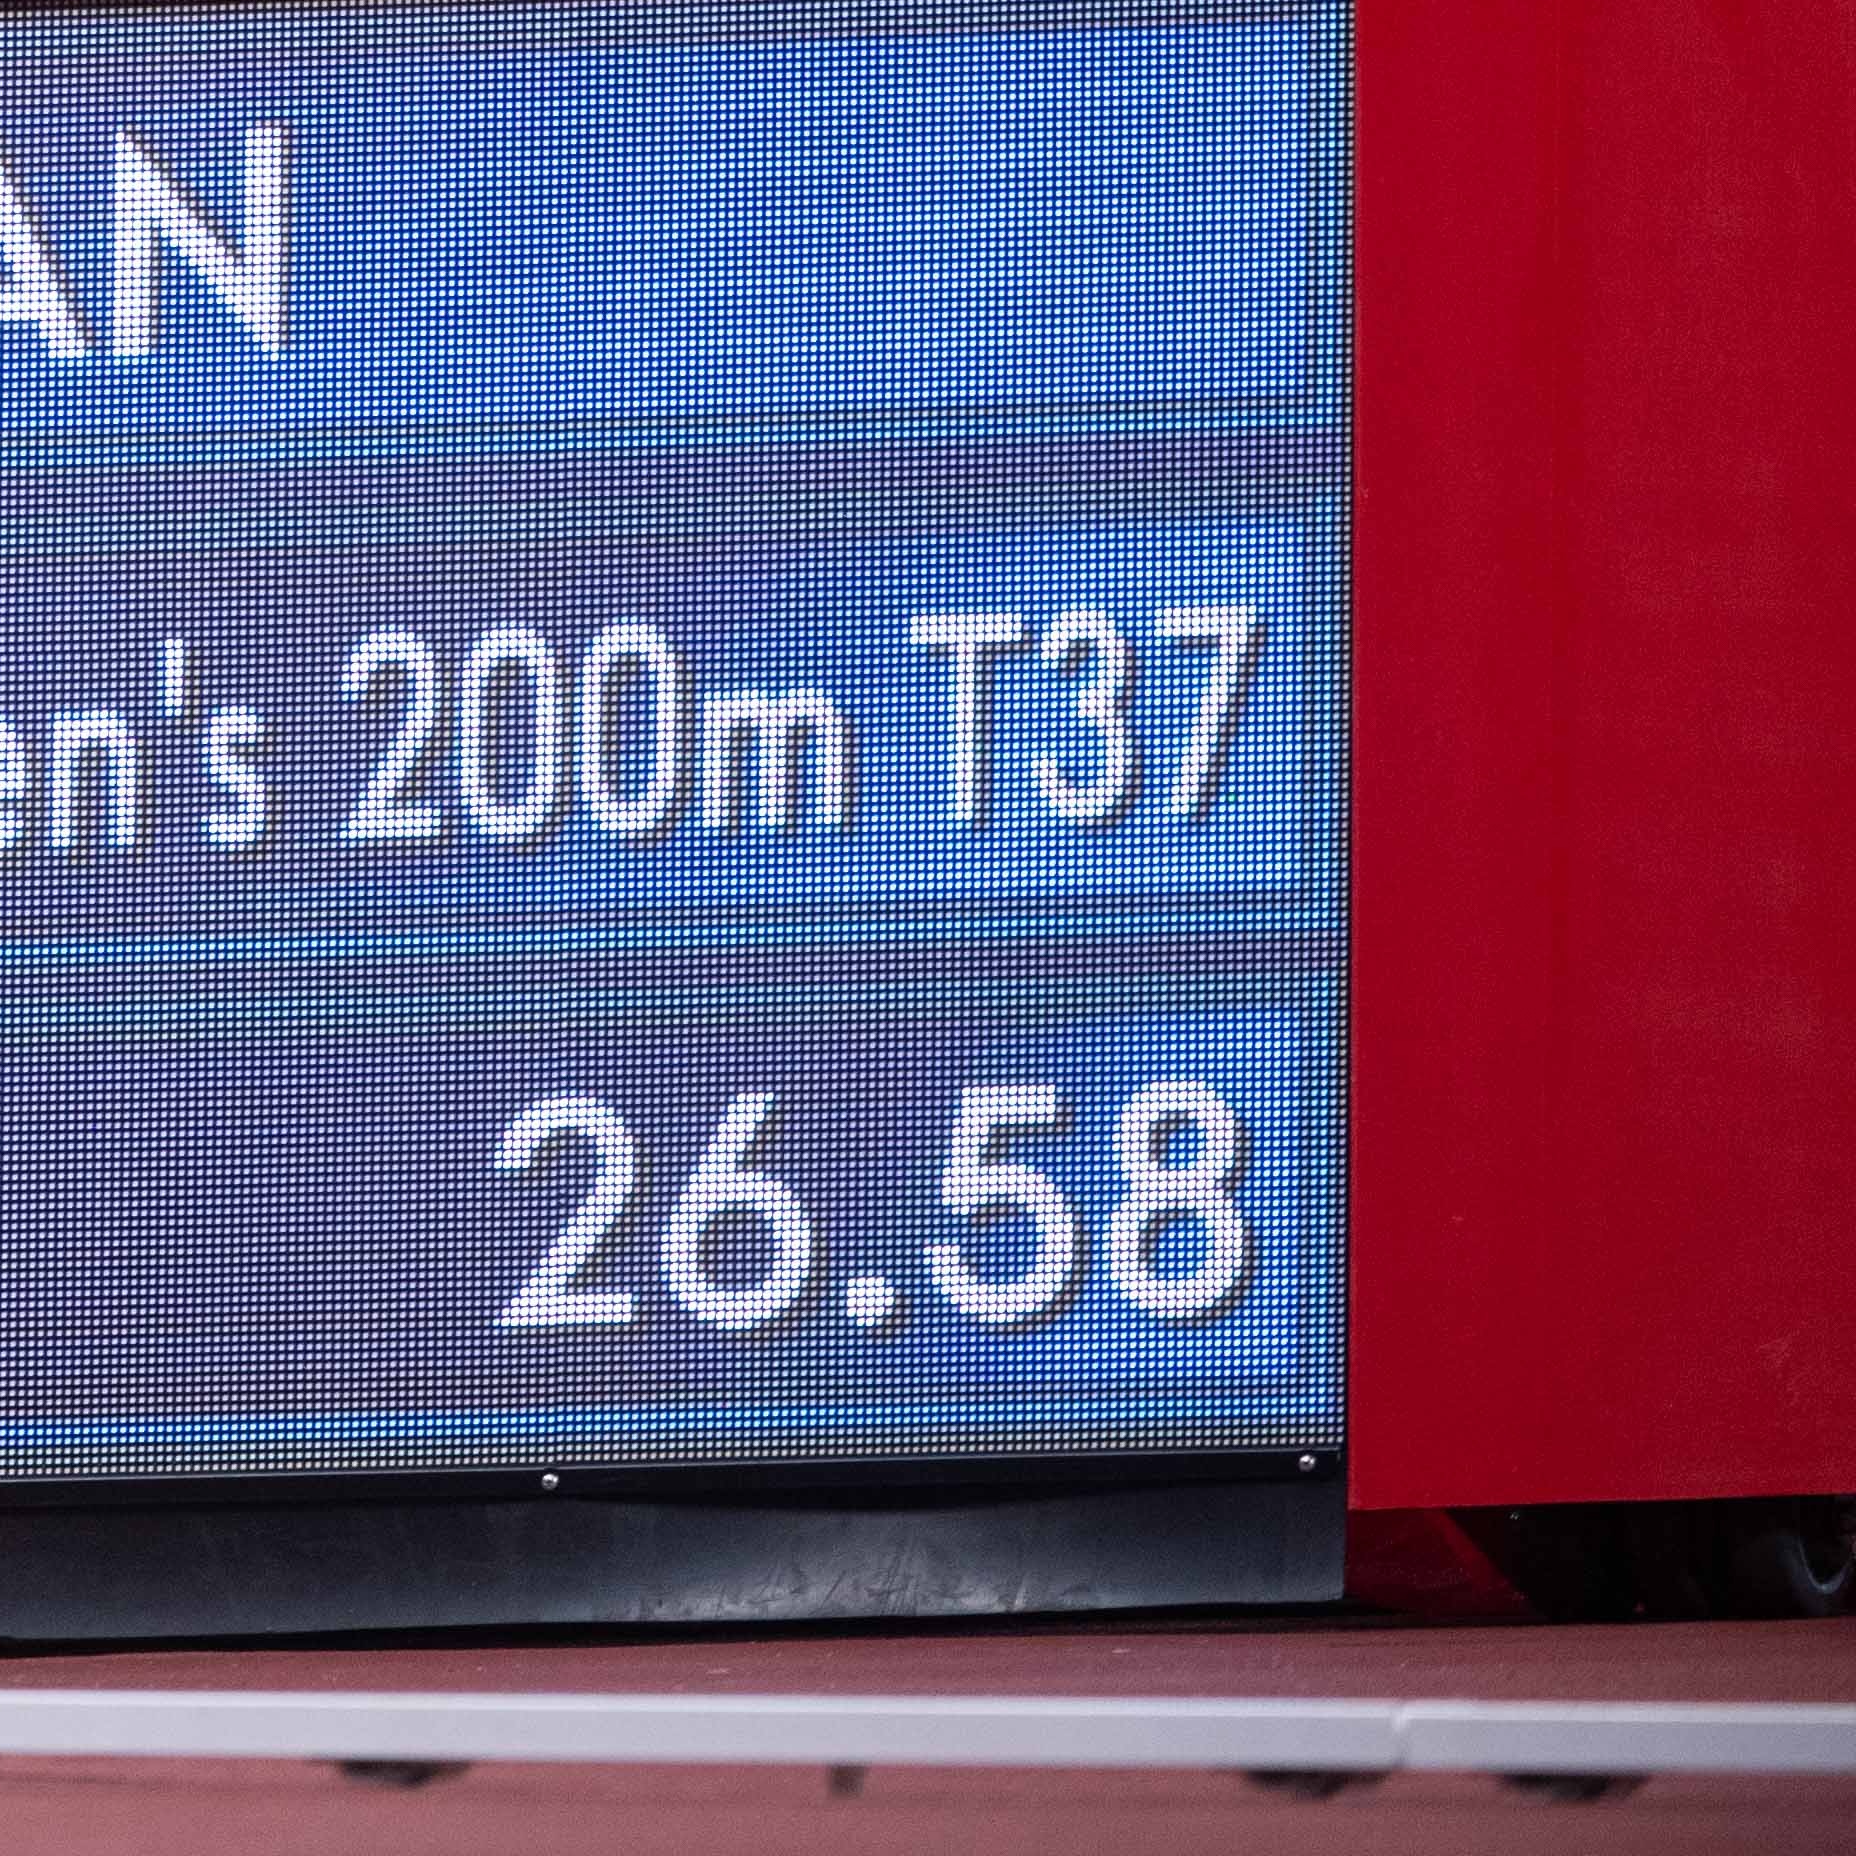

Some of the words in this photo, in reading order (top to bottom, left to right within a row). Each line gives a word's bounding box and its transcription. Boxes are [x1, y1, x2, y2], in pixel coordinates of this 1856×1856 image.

[336, 620, 848, 844] 200m
[908, 603, 1258, 828] T37
[491, 1076, 1258, 1332] 26.58
